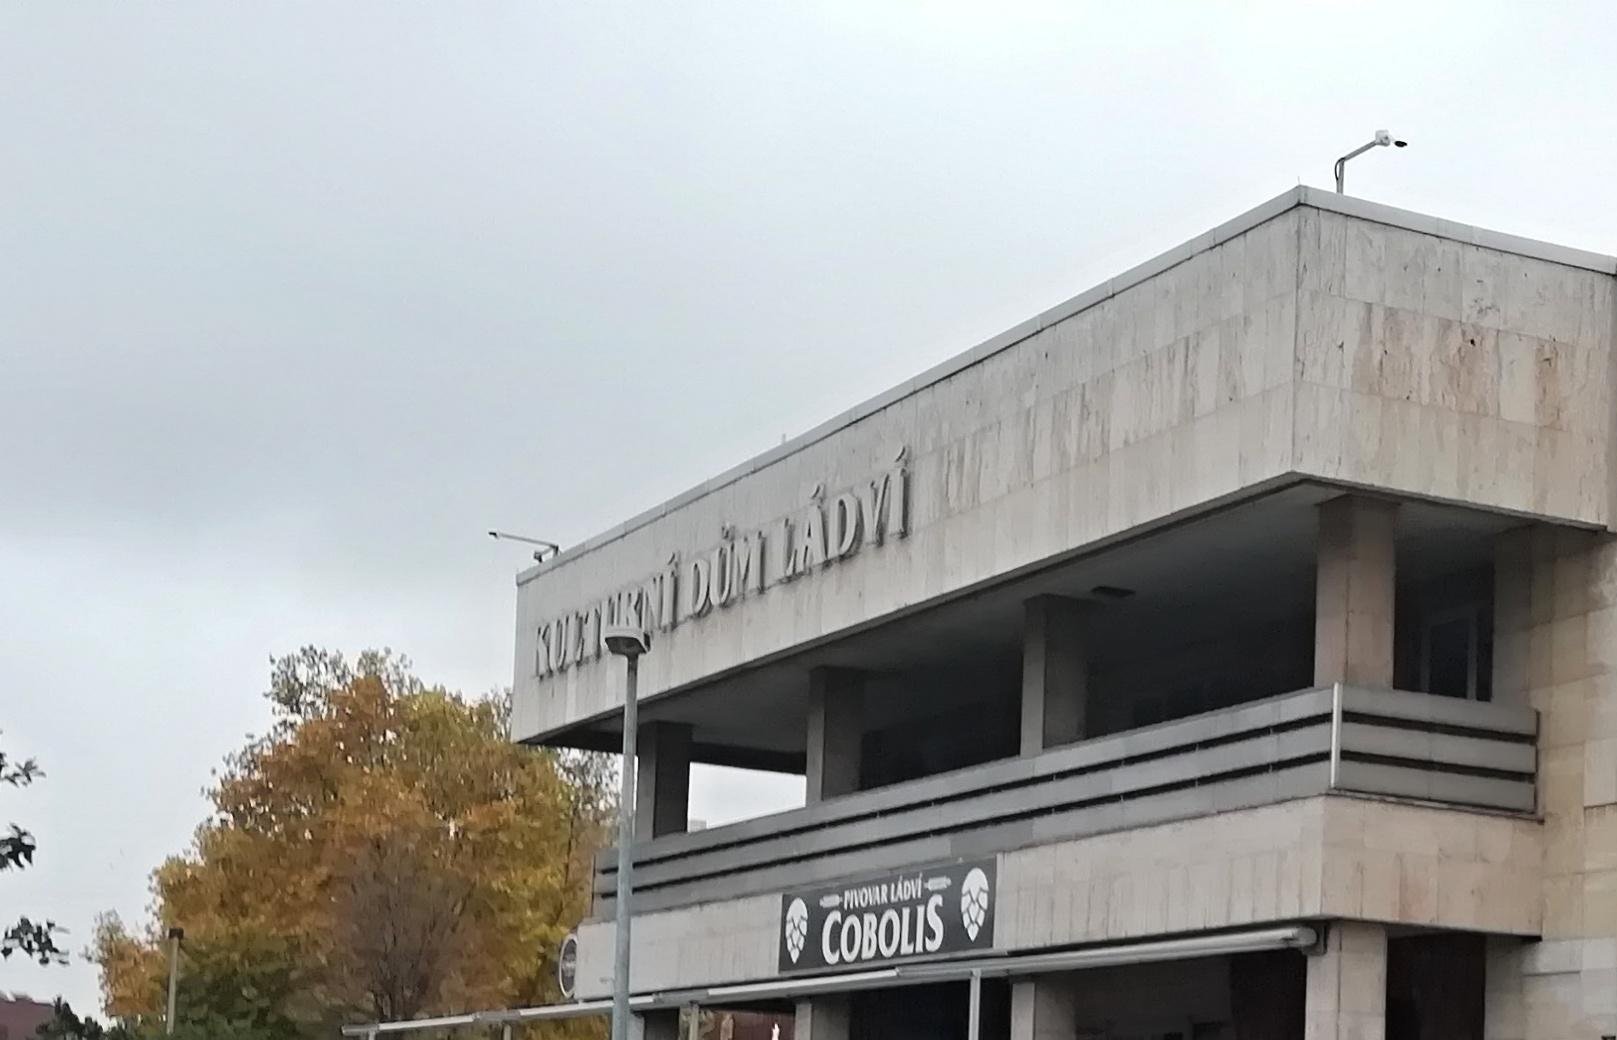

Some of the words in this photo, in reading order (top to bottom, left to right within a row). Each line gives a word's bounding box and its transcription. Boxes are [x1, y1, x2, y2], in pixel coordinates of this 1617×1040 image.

[688, 523, 766, 618] DŮM
[783, 446, 910, 582] LÁDVÍ
[843, 883, 889, 911] PIVOVAR
[890, 872, 923, 902] LÁDVÍ
[822, 893, 944, 965] COBOLIS
